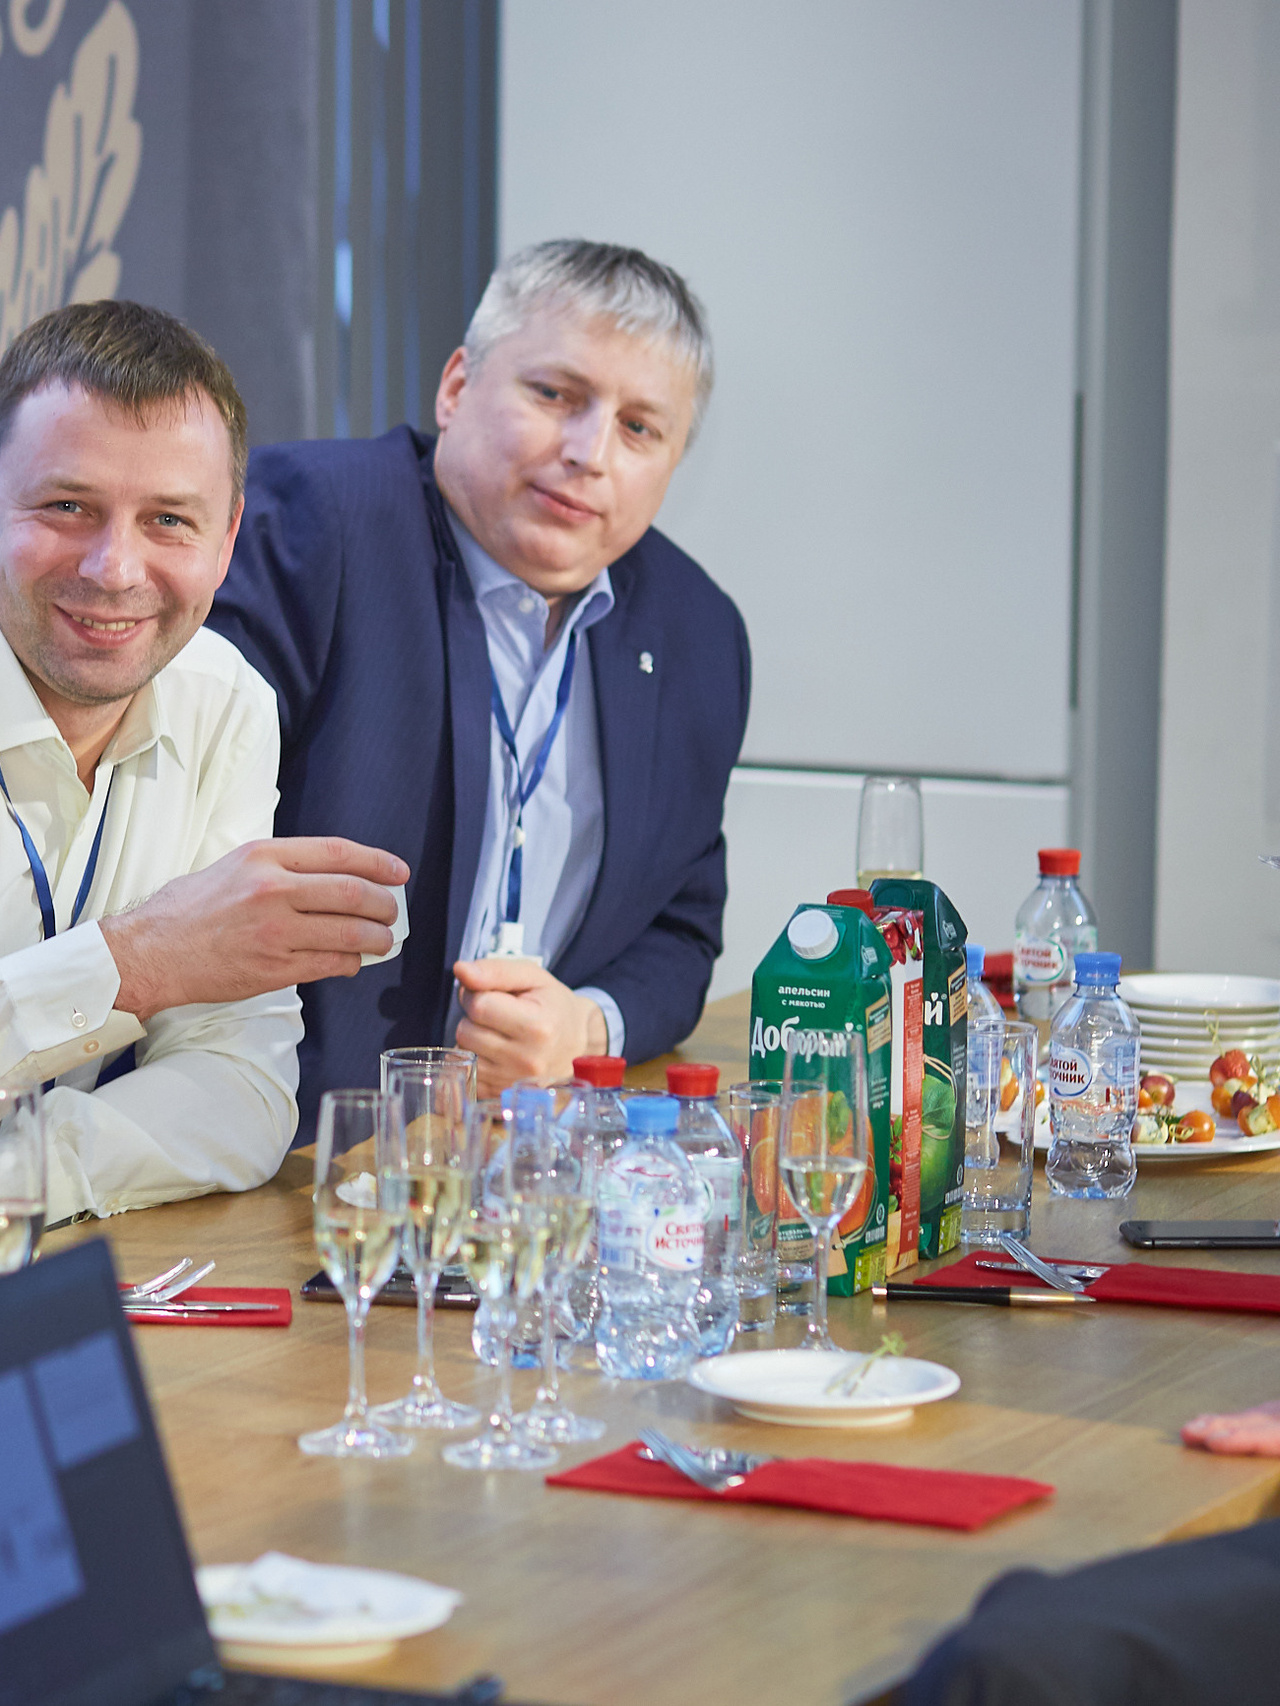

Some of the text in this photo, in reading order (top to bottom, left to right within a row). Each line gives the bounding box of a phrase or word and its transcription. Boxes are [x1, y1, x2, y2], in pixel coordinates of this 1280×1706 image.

[778, 985, 830, 998] апельсин
[788, 1000, 826, 1009] мякотью
[751, 1015, 854, 1063] Добрый
